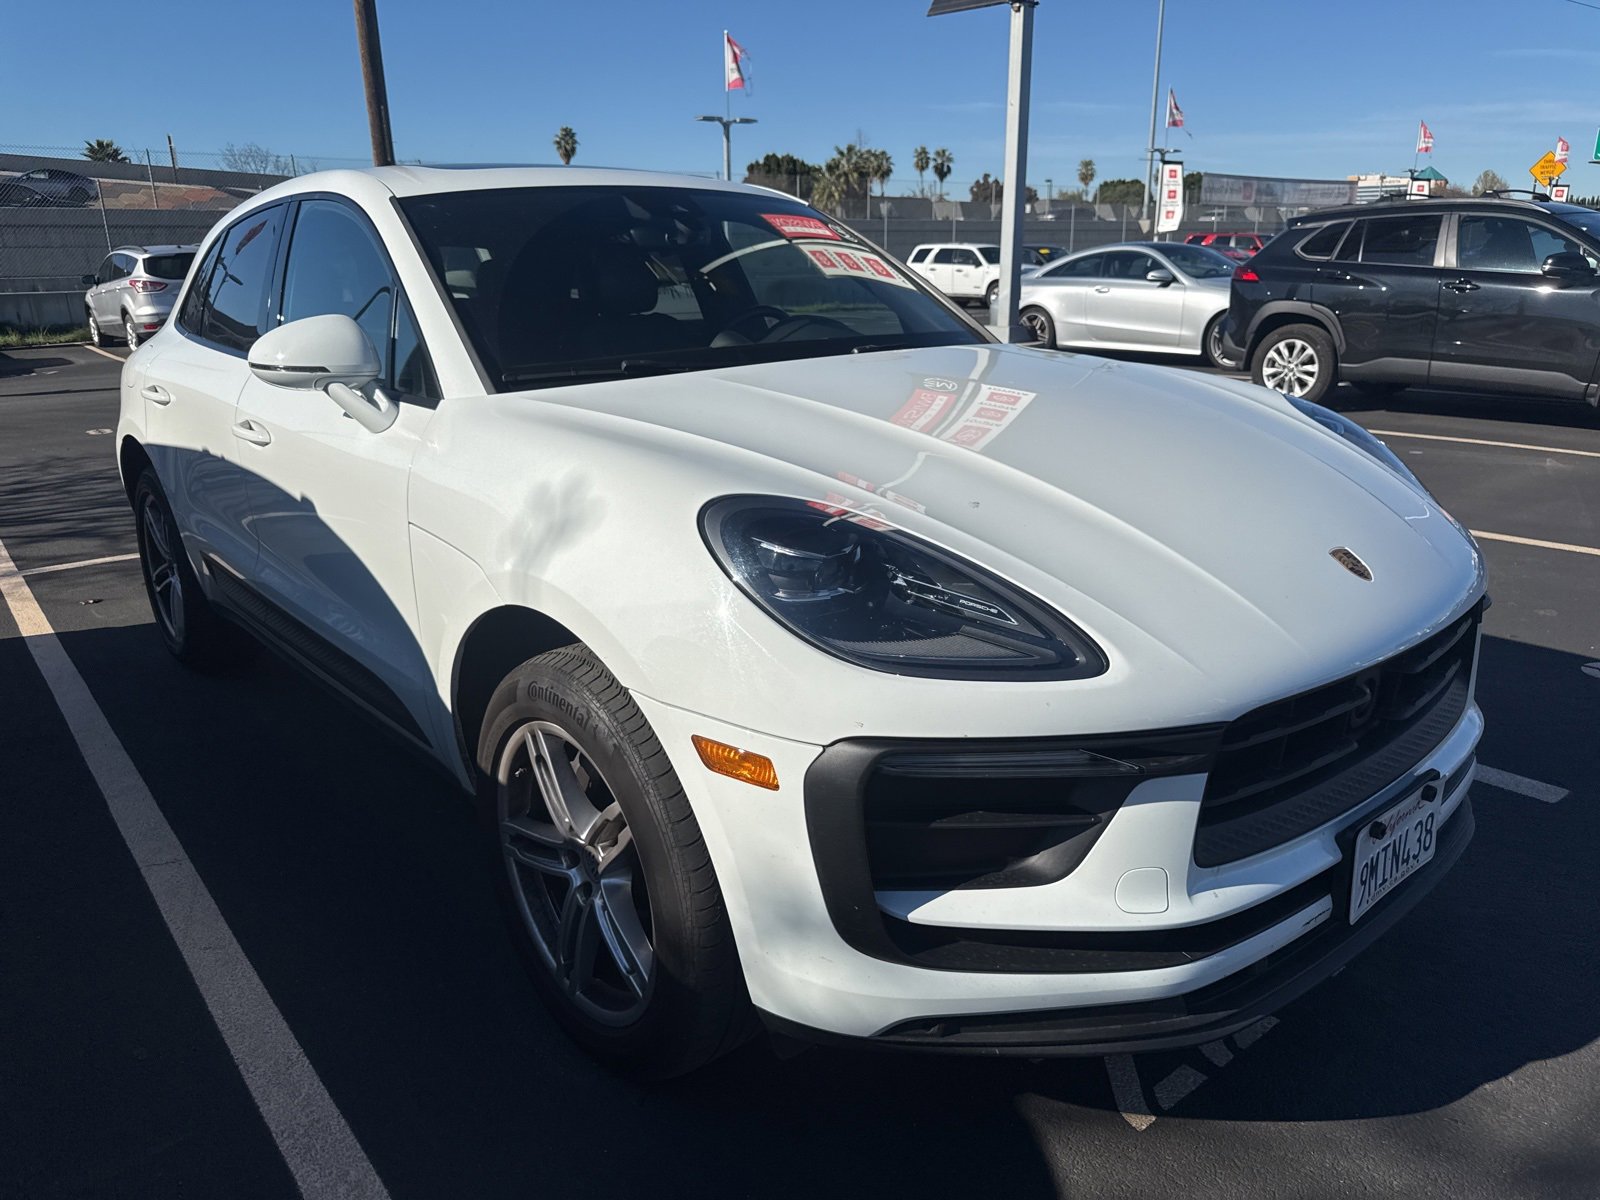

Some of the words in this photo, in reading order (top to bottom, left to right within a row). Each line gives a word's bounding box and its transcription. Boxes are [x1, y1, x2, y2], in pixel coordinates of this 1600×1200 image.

[958, 599, 999, 614] PORSCHE
[527, 680, 592, 729] Continental
[1357, 811, 1435, 909] 9MIN438
